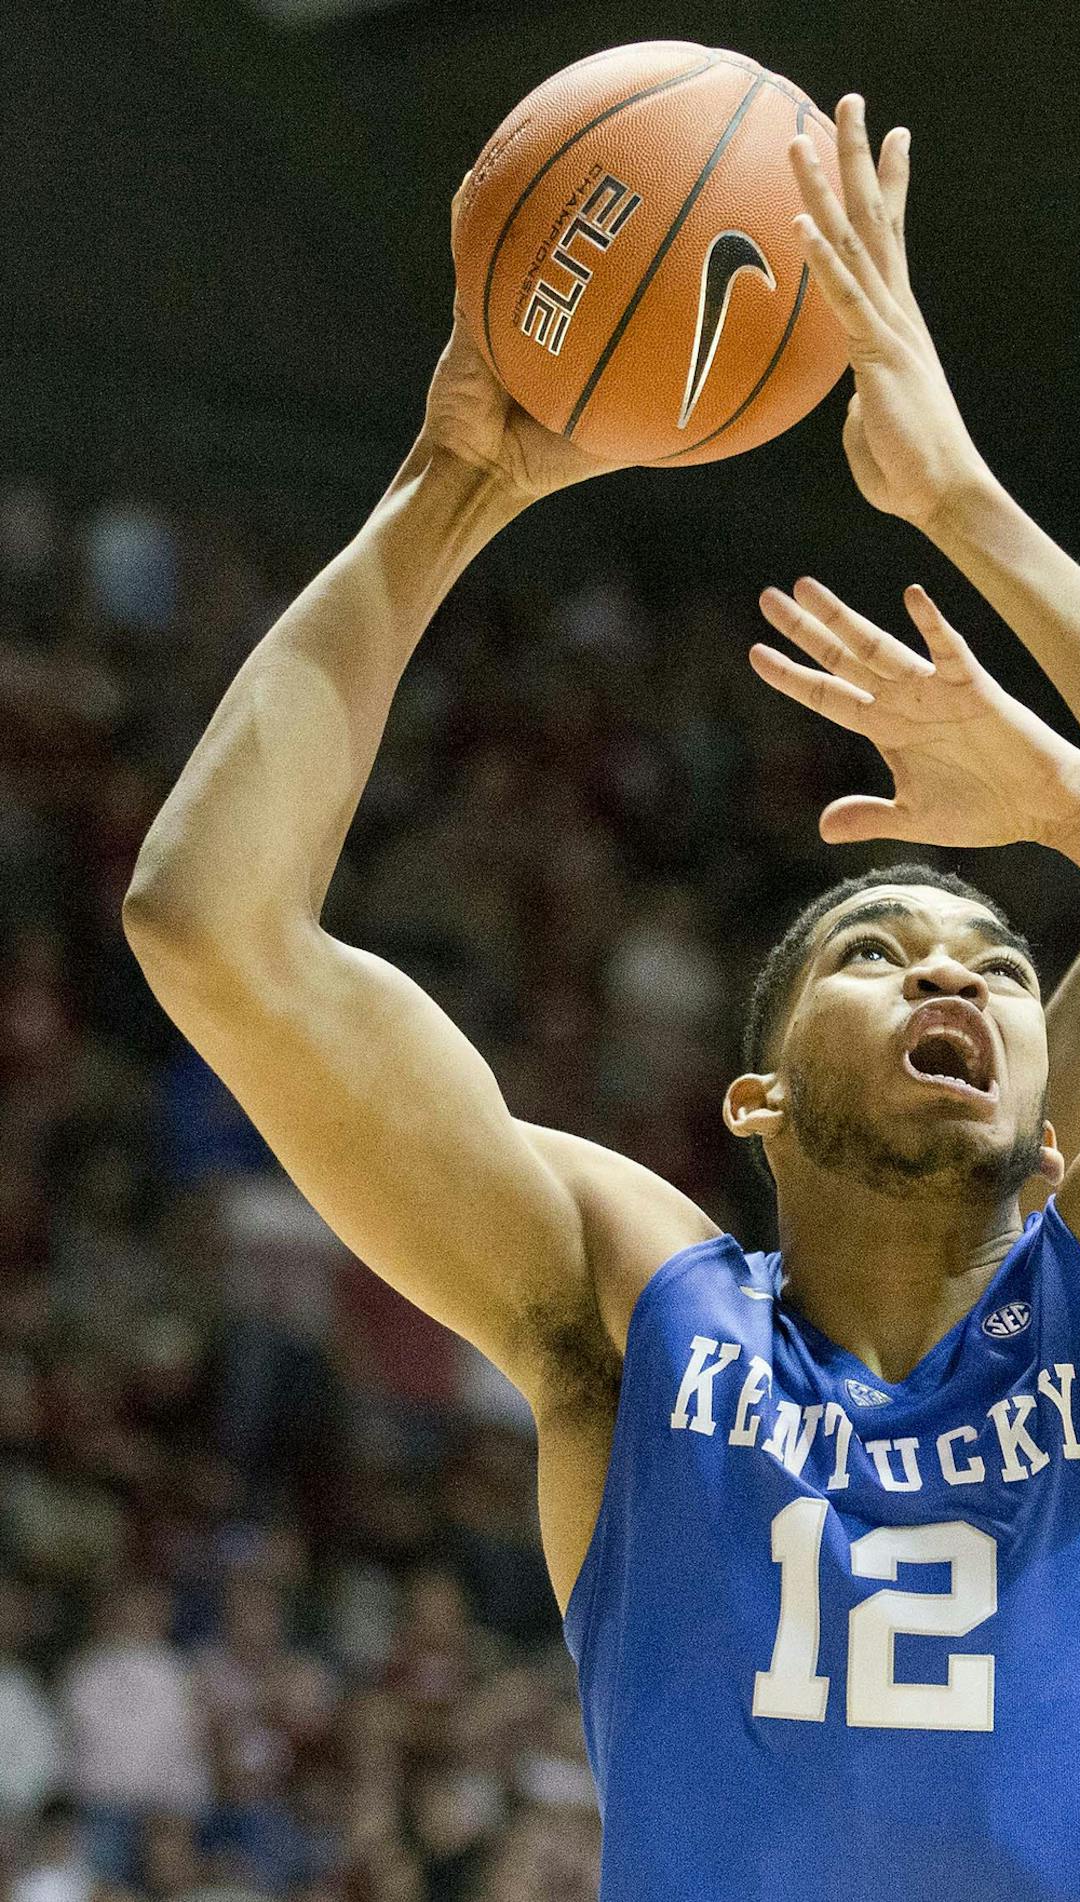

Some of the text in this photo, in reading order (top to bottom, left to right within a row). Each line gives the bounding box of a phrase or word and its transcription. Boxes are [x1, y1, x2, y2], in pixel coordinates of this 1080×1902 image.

[522, 174, 642, 356] ELITE
[985, 1304, 1030, 1334] SEC
[752, 1496, 998, 1732] 12
